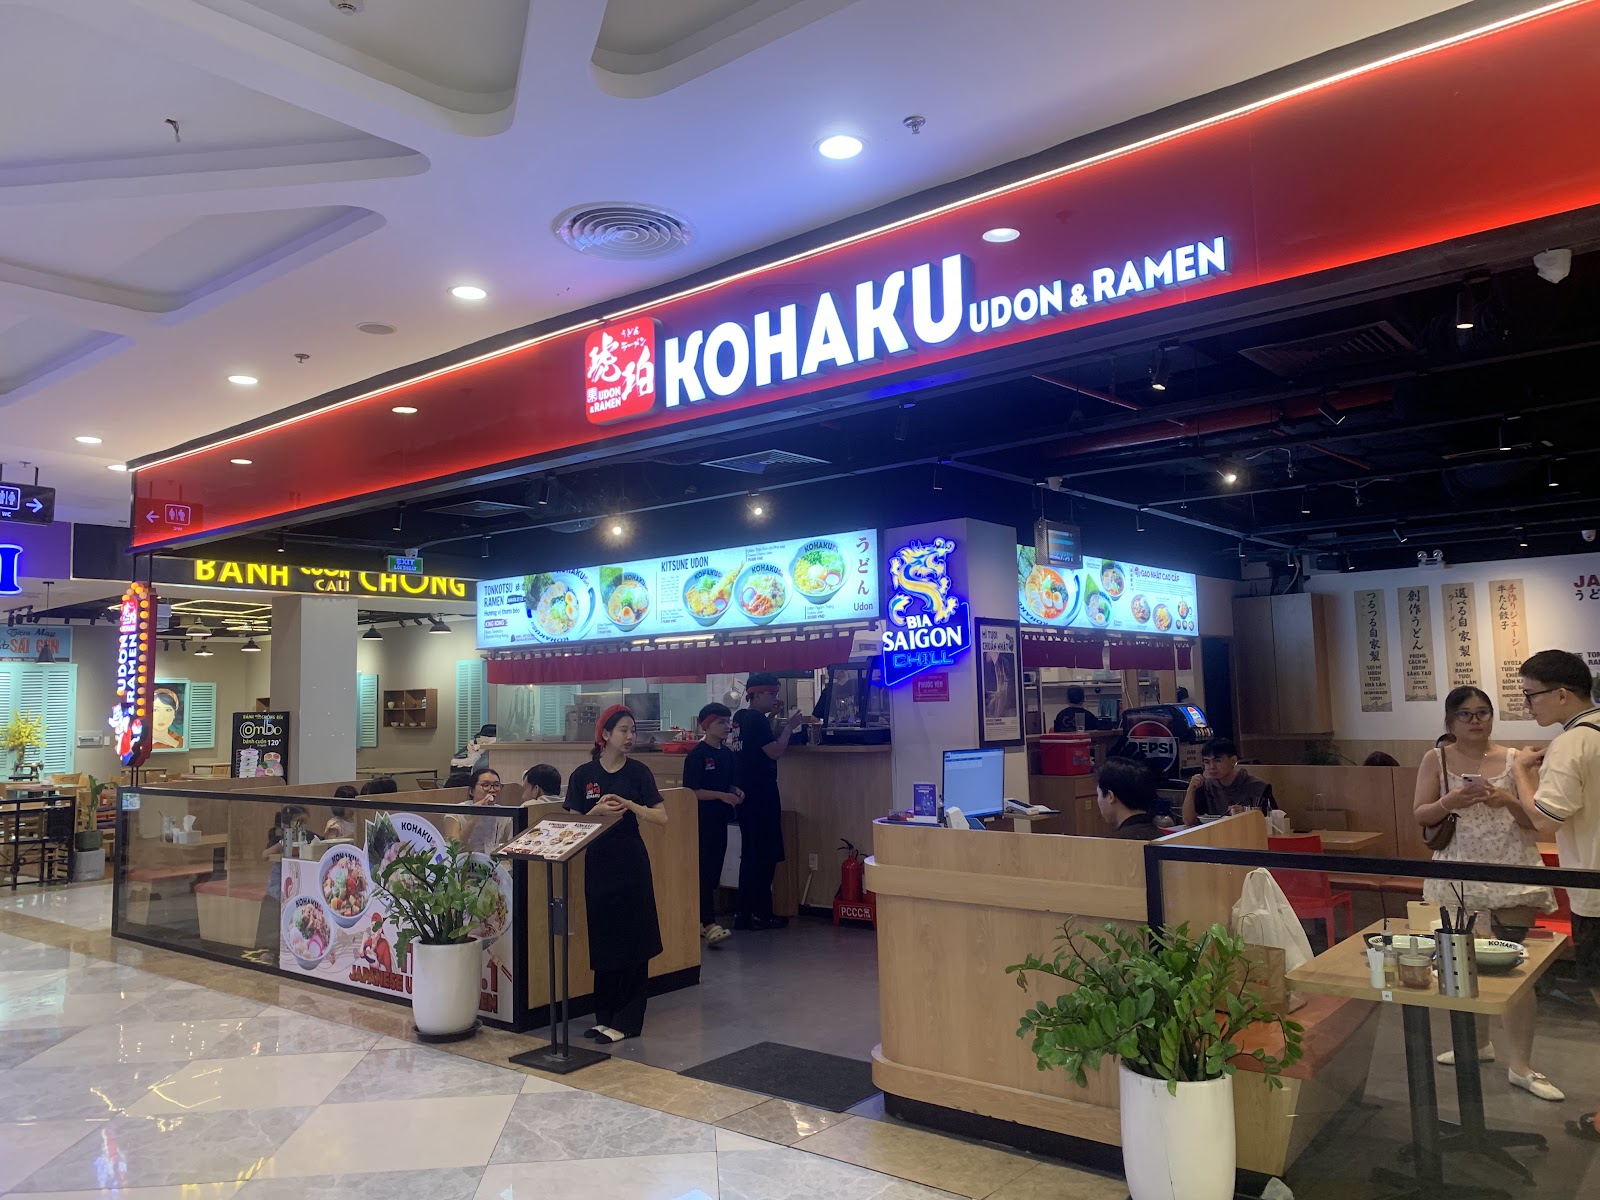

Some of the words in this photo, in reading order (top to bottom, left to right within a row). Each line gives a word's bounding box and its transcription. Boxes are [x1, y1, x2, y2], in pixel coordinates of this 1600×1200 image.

[969, 279, 1064, 334] UDON
[1069, 283, 1089, 308] &
[1093, 236, 1228, 303] RAMEN
[664, 254, 966, 408] KOHAKU
[598, 386, 622, 401] UDON
[804, 541, 833, 553] KOHAKU
[396, 558, 415, 566] EXIT
[661, 558, 689, 572] KITSUNE
[690, 556, 709, 569] UDON
[751, 564, 779, 574] KOHAKU
[856, 536, 870, 596] うどん
[314, 579, 350, 592] CALI
[484, 583, 513, 596] TONKOTSU
[483, 596, 505, 608] RAMEN
[853, 602, 873, 611] Udon
[906, 614, 933, 629] BIA
[1366, 592, 1381, 662] つるつる自家製
[1407, 589, 1424, 651] 創作うどん
[1455, 587, 1471, 657] 選べる自家製
[882, 626, 962, 651] SAIGON
[117, 634, 129, 692] UDON
[893, 649, 954, 668] CHILL
[126, 633, 138, 707] RAMEN
[401, 821, 433, 843] KOHAKU
[841, 906, 863, 918] PCCC
[349, 964, 403, 993] JAPANESE
